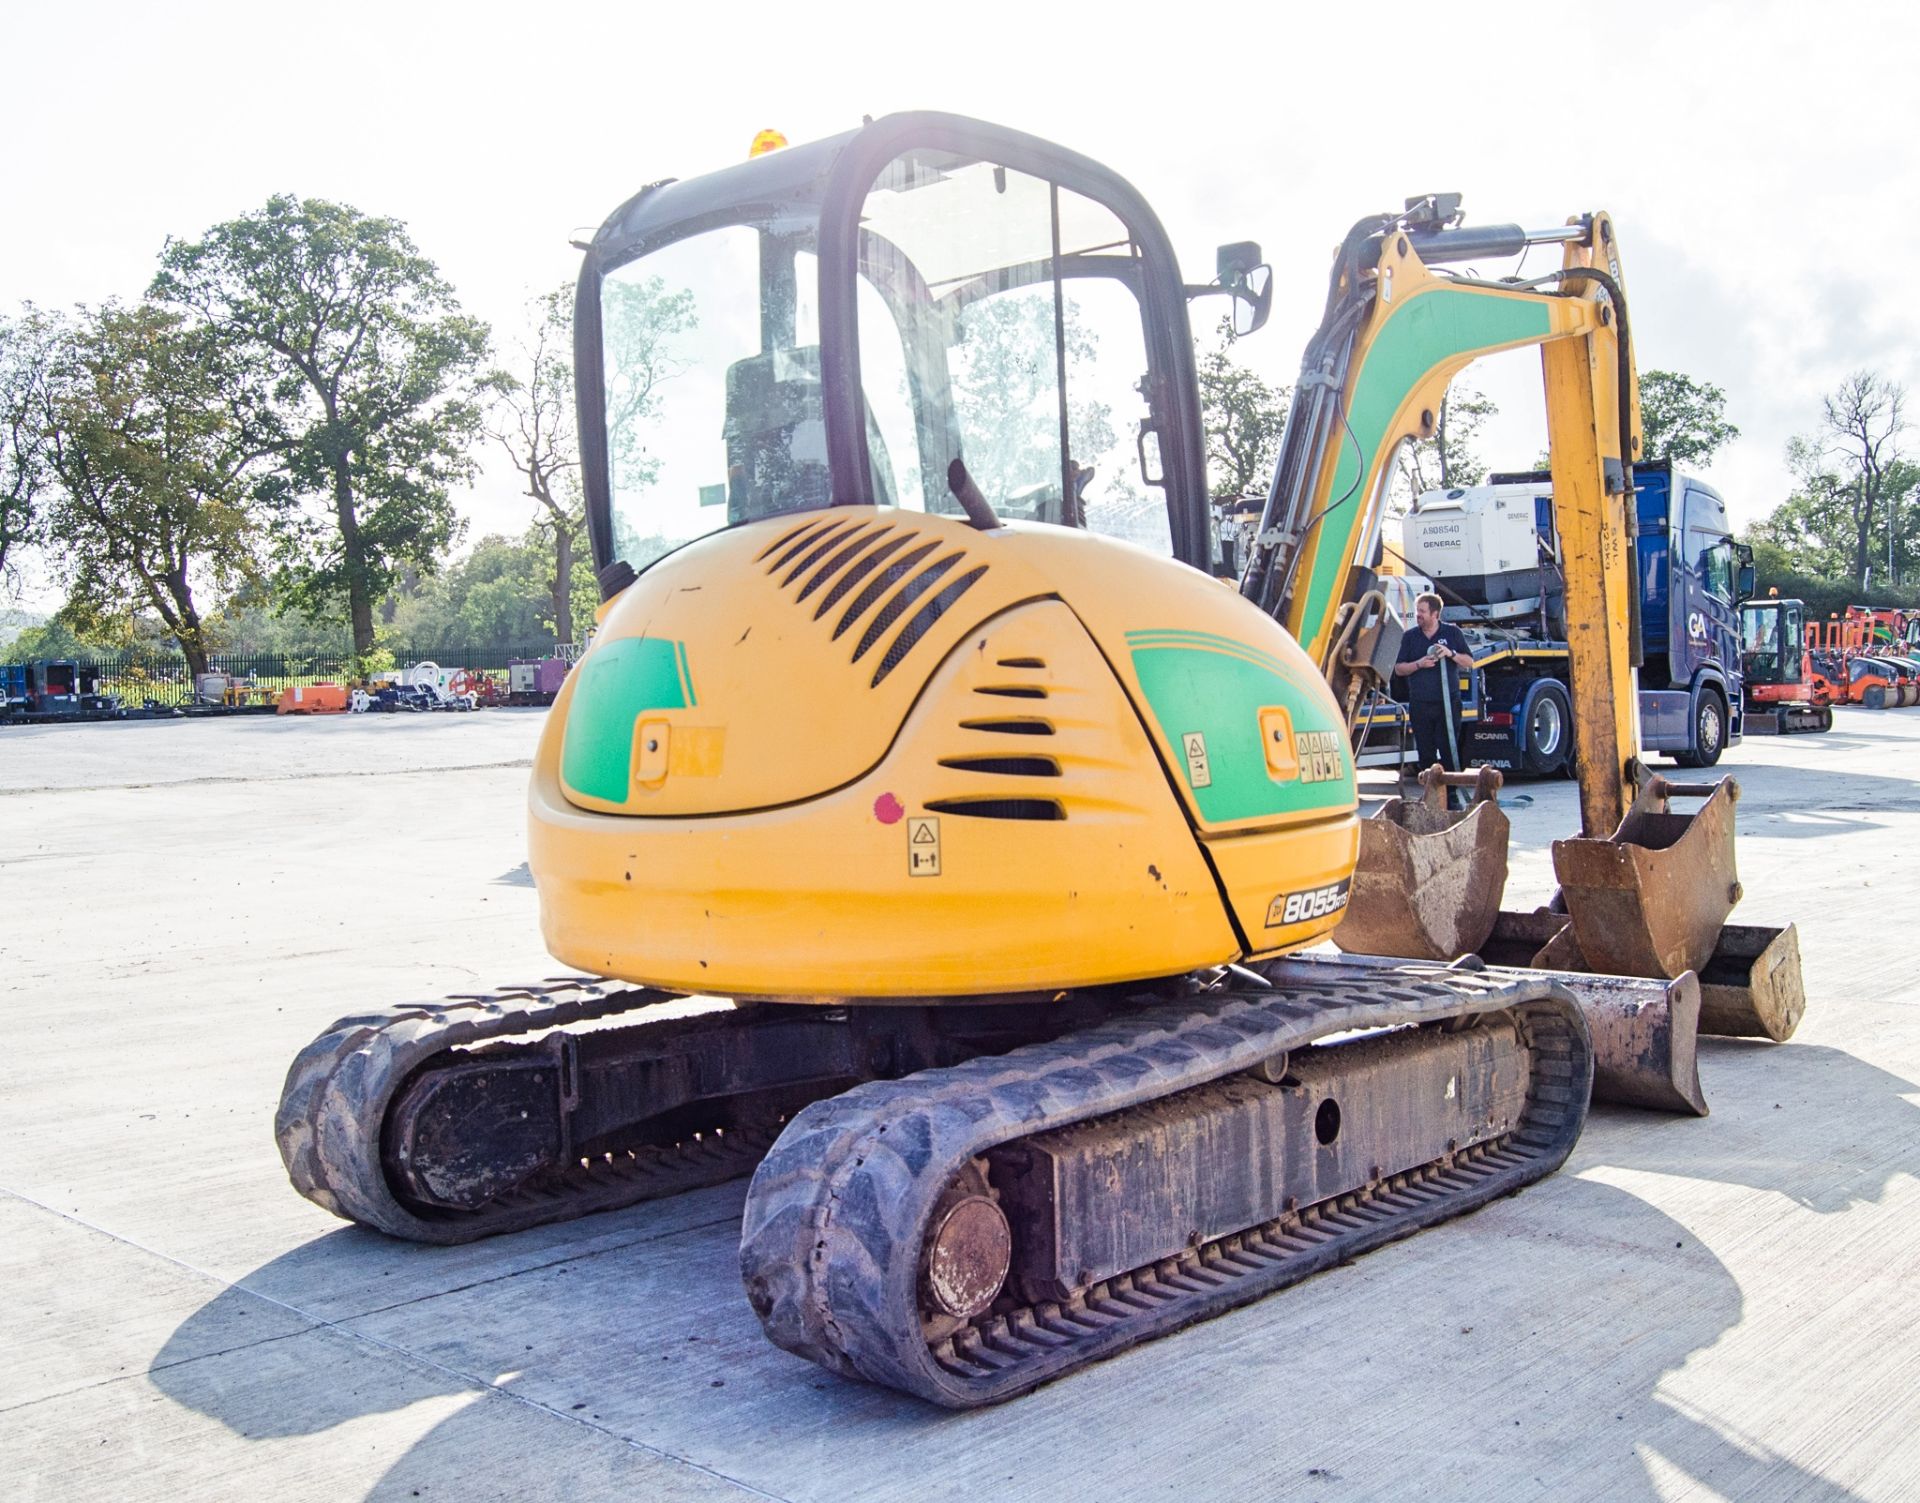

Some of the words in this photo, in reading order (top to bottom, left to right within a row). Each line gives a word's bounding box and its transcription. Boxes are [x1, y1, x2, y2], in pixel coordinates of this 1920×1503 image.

[1507, 512, 1529, 520] GENERAC
[1423, 539, 1461, 548] GENERAC
[1474, 732, 1509, 740] SCANIA
